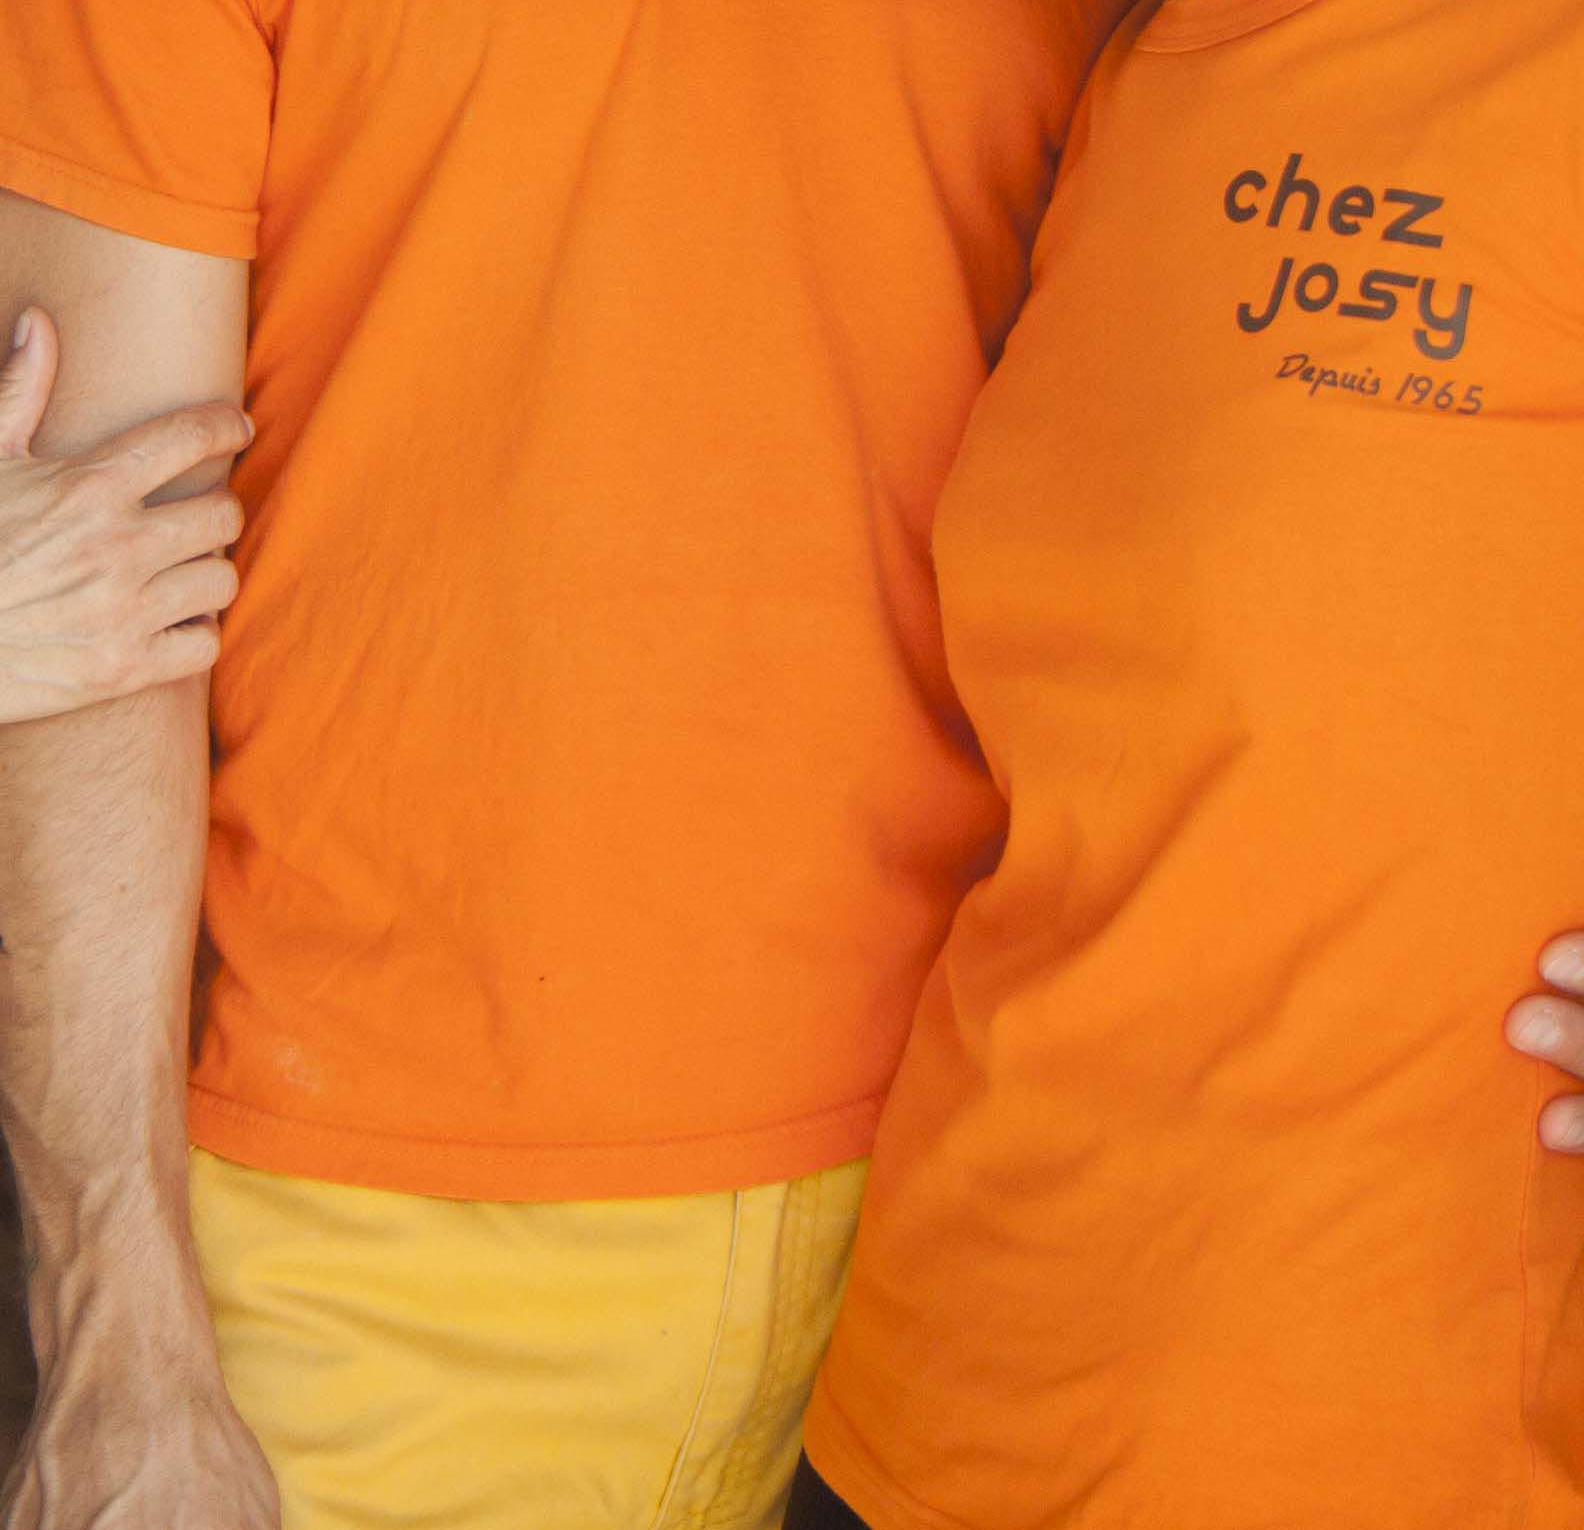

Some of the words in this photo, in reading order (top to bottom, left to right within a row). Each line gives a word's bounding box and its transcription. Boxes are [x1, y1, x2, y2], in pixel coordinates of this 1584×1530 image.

[1223, 152, 1445, 249] chez
[1275, 352, 1382, 398] Depuis
[1394, 372, 1485, 416] 1965
